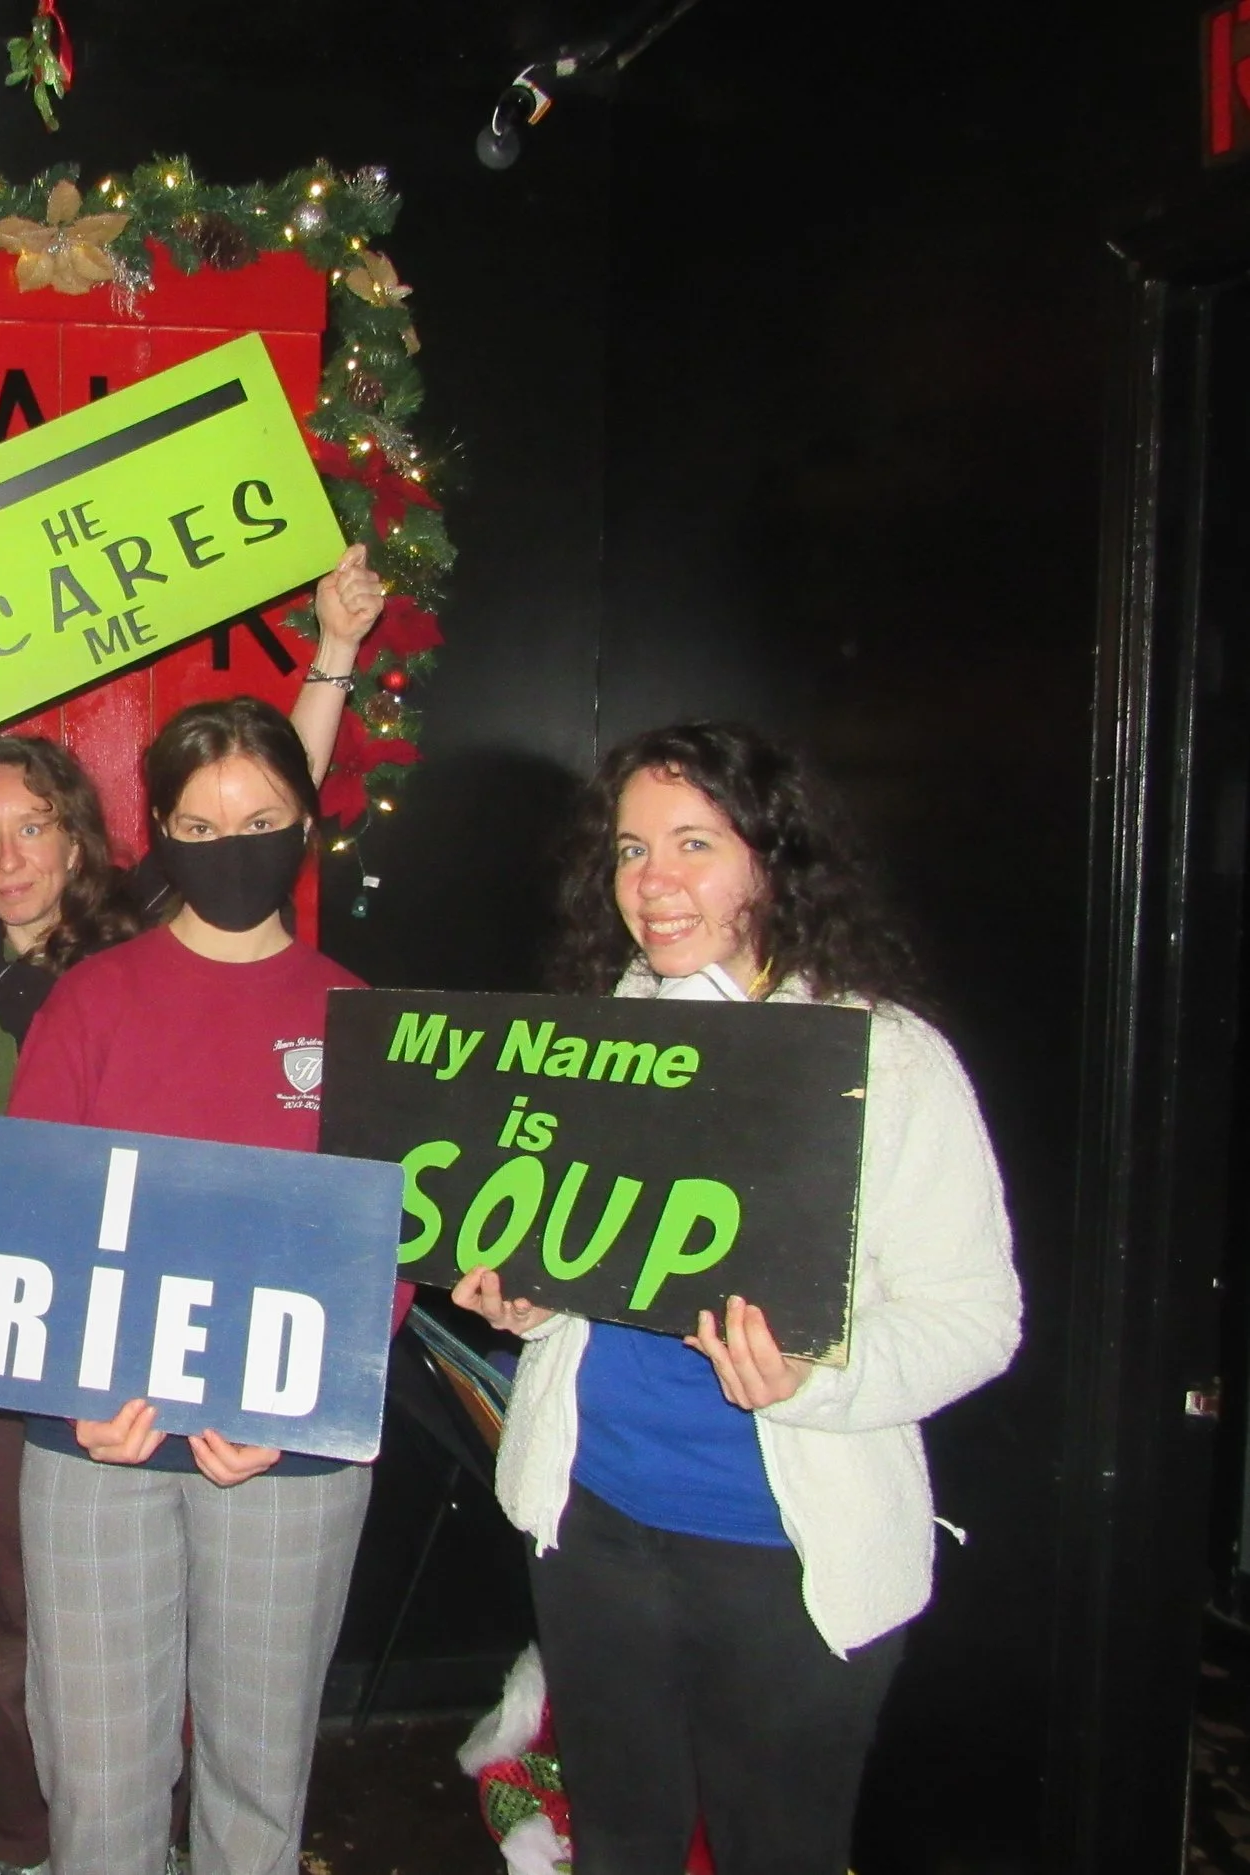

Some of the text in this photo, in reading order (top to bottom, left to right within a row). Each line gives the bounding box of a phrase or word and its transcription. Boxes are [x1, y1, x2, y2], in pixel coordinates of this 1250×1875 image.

[41, 500, 107, 556] HE
[82, 605, 158, 665] ME
[387, 1012, 700, 1089] My Name
[497, 1096, 559, 1152] is
[98, 1147, 138, 1252] I
[396, 1140, 740, 1310] SOUP
